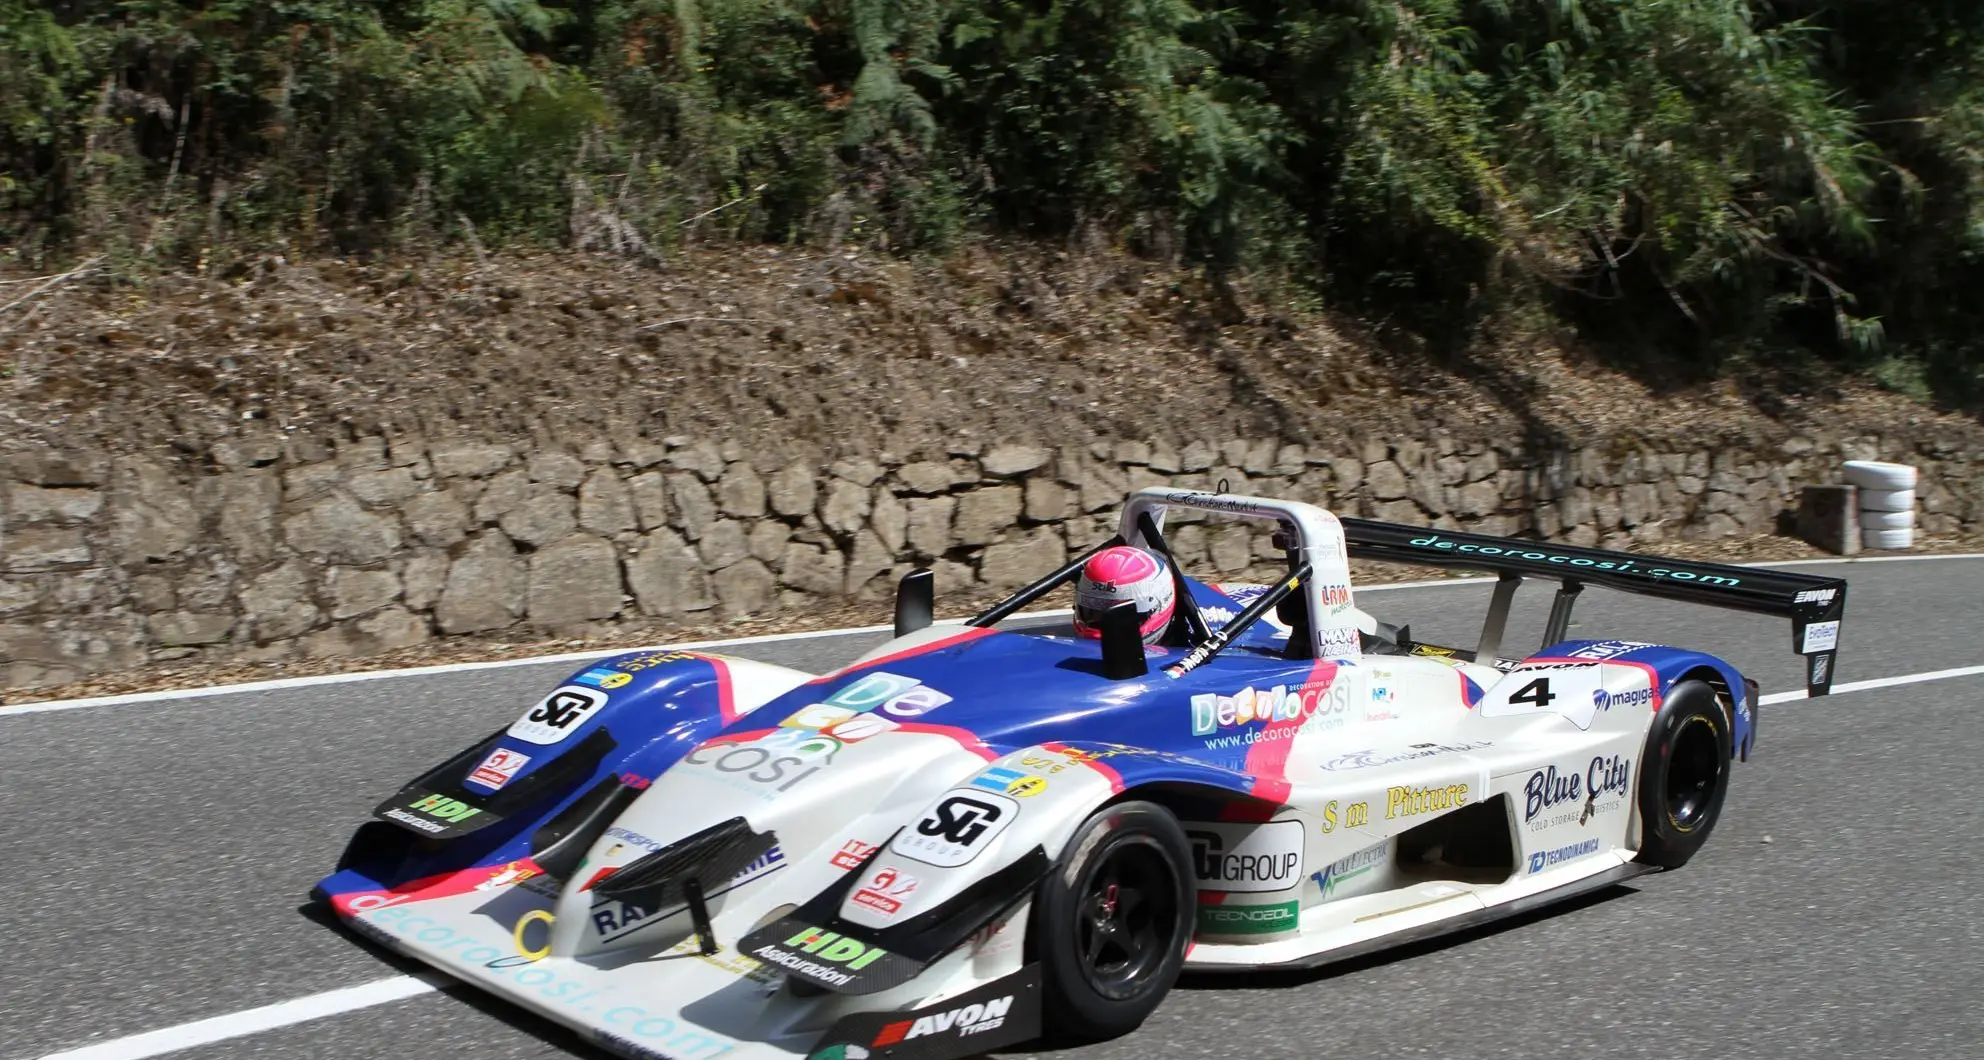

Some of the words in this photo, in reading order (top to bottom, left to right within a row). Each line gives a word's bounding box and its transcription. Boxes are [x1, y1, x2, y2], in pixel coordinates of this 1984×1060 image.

[1410, 535, 1741, 586] decorocosi.com
[1804, 588, 1837, 602] AVON
[530, 692, 595, 729] SG
[1508, 677, 1556, 708] 4
[408, 793, 483, 823] HDI
[1385, 783, 1468, 820] Pitture
[1524, 765, 1581, 826] Blue
[1587, 754, 1631, 798] City
[917, 796, 1002, 847] SG
[902, 836, 963, 857] GROUP
[1186, 830, 1223, 880] G
[1223, 852, 1298, 882] GROUP
[1546, 837, 1600, 866] TECNODINAMICA
[752, 944, 855, 986] Assicurazioni
[784, 926, 887, 970] HDI
[348, 894, 736, 1056] decorocosi.com
[904, 996, 1015, 1040] AVON
[959, 1016, 1006, 1038] TYRES
